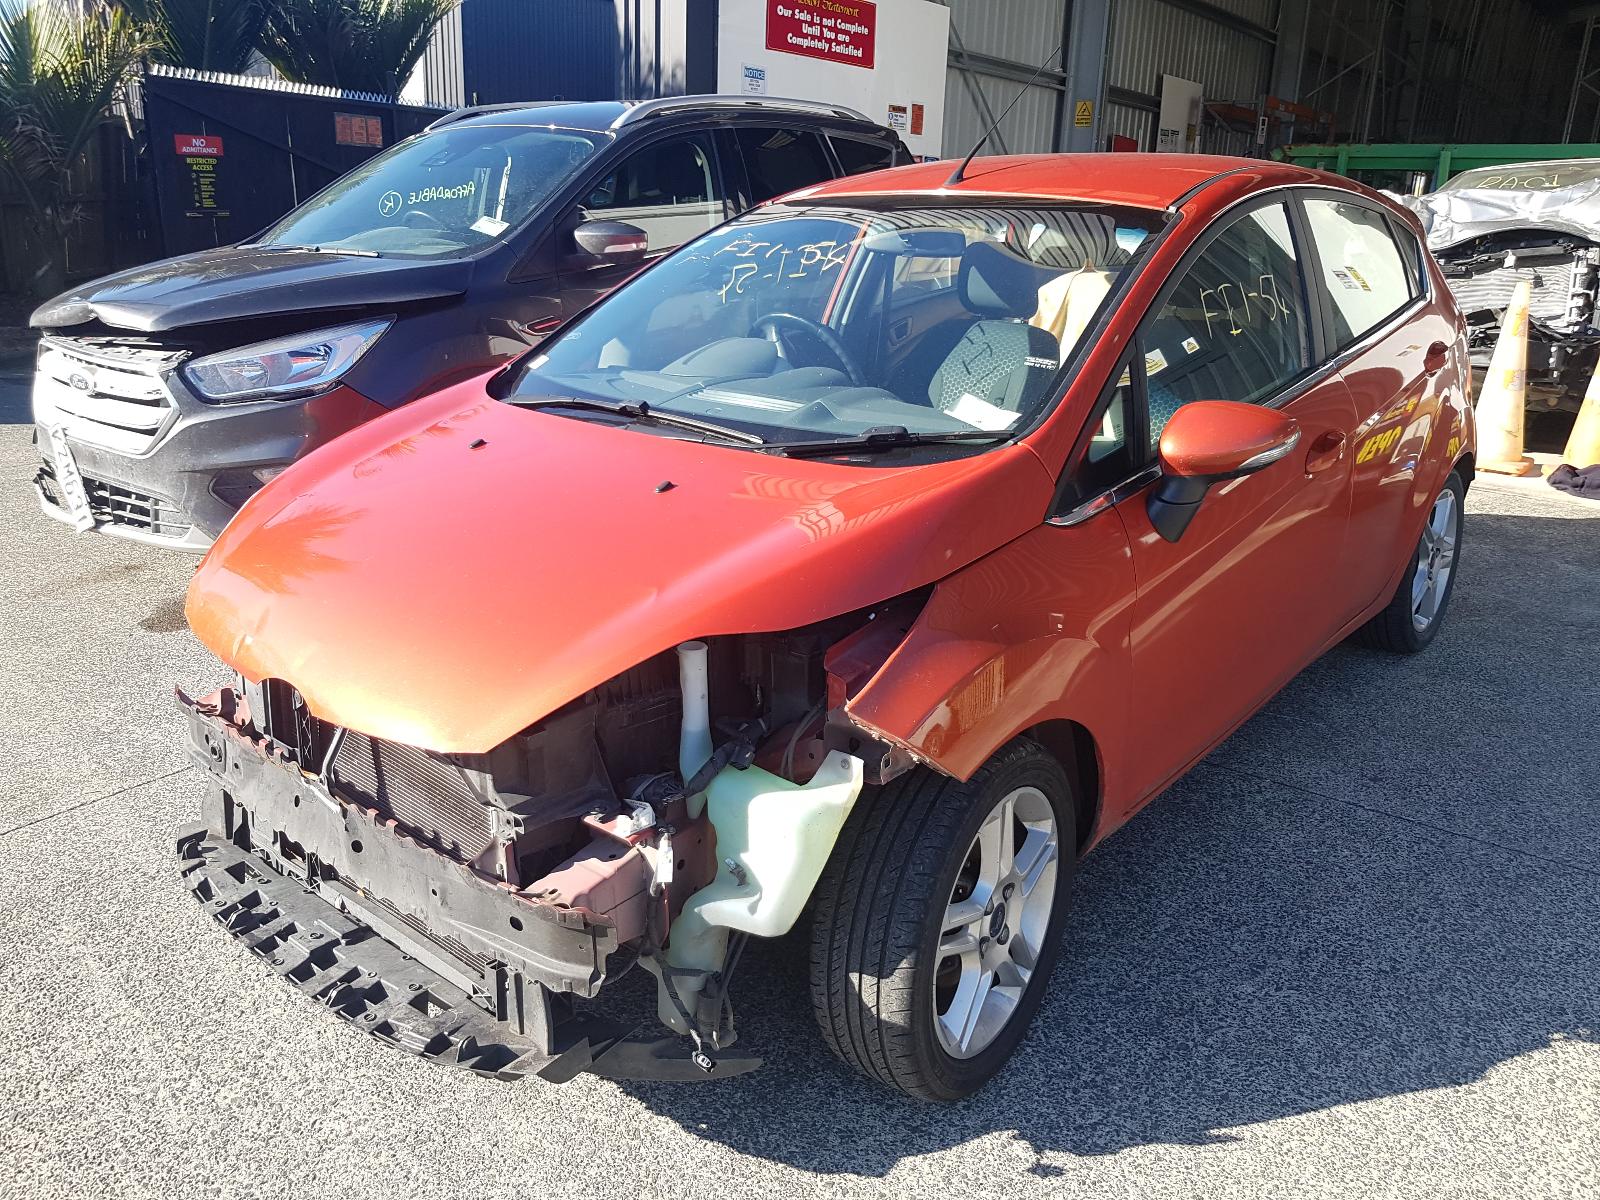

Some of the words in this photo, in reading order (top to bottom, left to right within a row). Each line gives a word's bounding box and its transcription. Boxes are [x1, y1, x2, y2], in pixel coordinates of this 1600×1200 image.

[777, 5, 793, 18] Our
[794, 8, 812, 22] Sale
[813, 12, 821, 23] is
[822, 17, 836, 26] not
[836, 19, 869, 35] Complete
[802, 22, 821, 37] Until
[822, 27, 836, 40] You
[837, 34, 850, 43] are
[787, 32, 830, 53] Completely
[831, 42, 863, 58] Satisfied
[744, 68, 766, 80] NOTICE
[192, 138, 206, 147] NO
[182, 146, 218, 154] ADMITTANCE
[186, 157, 217, 165] RESTRICTED
